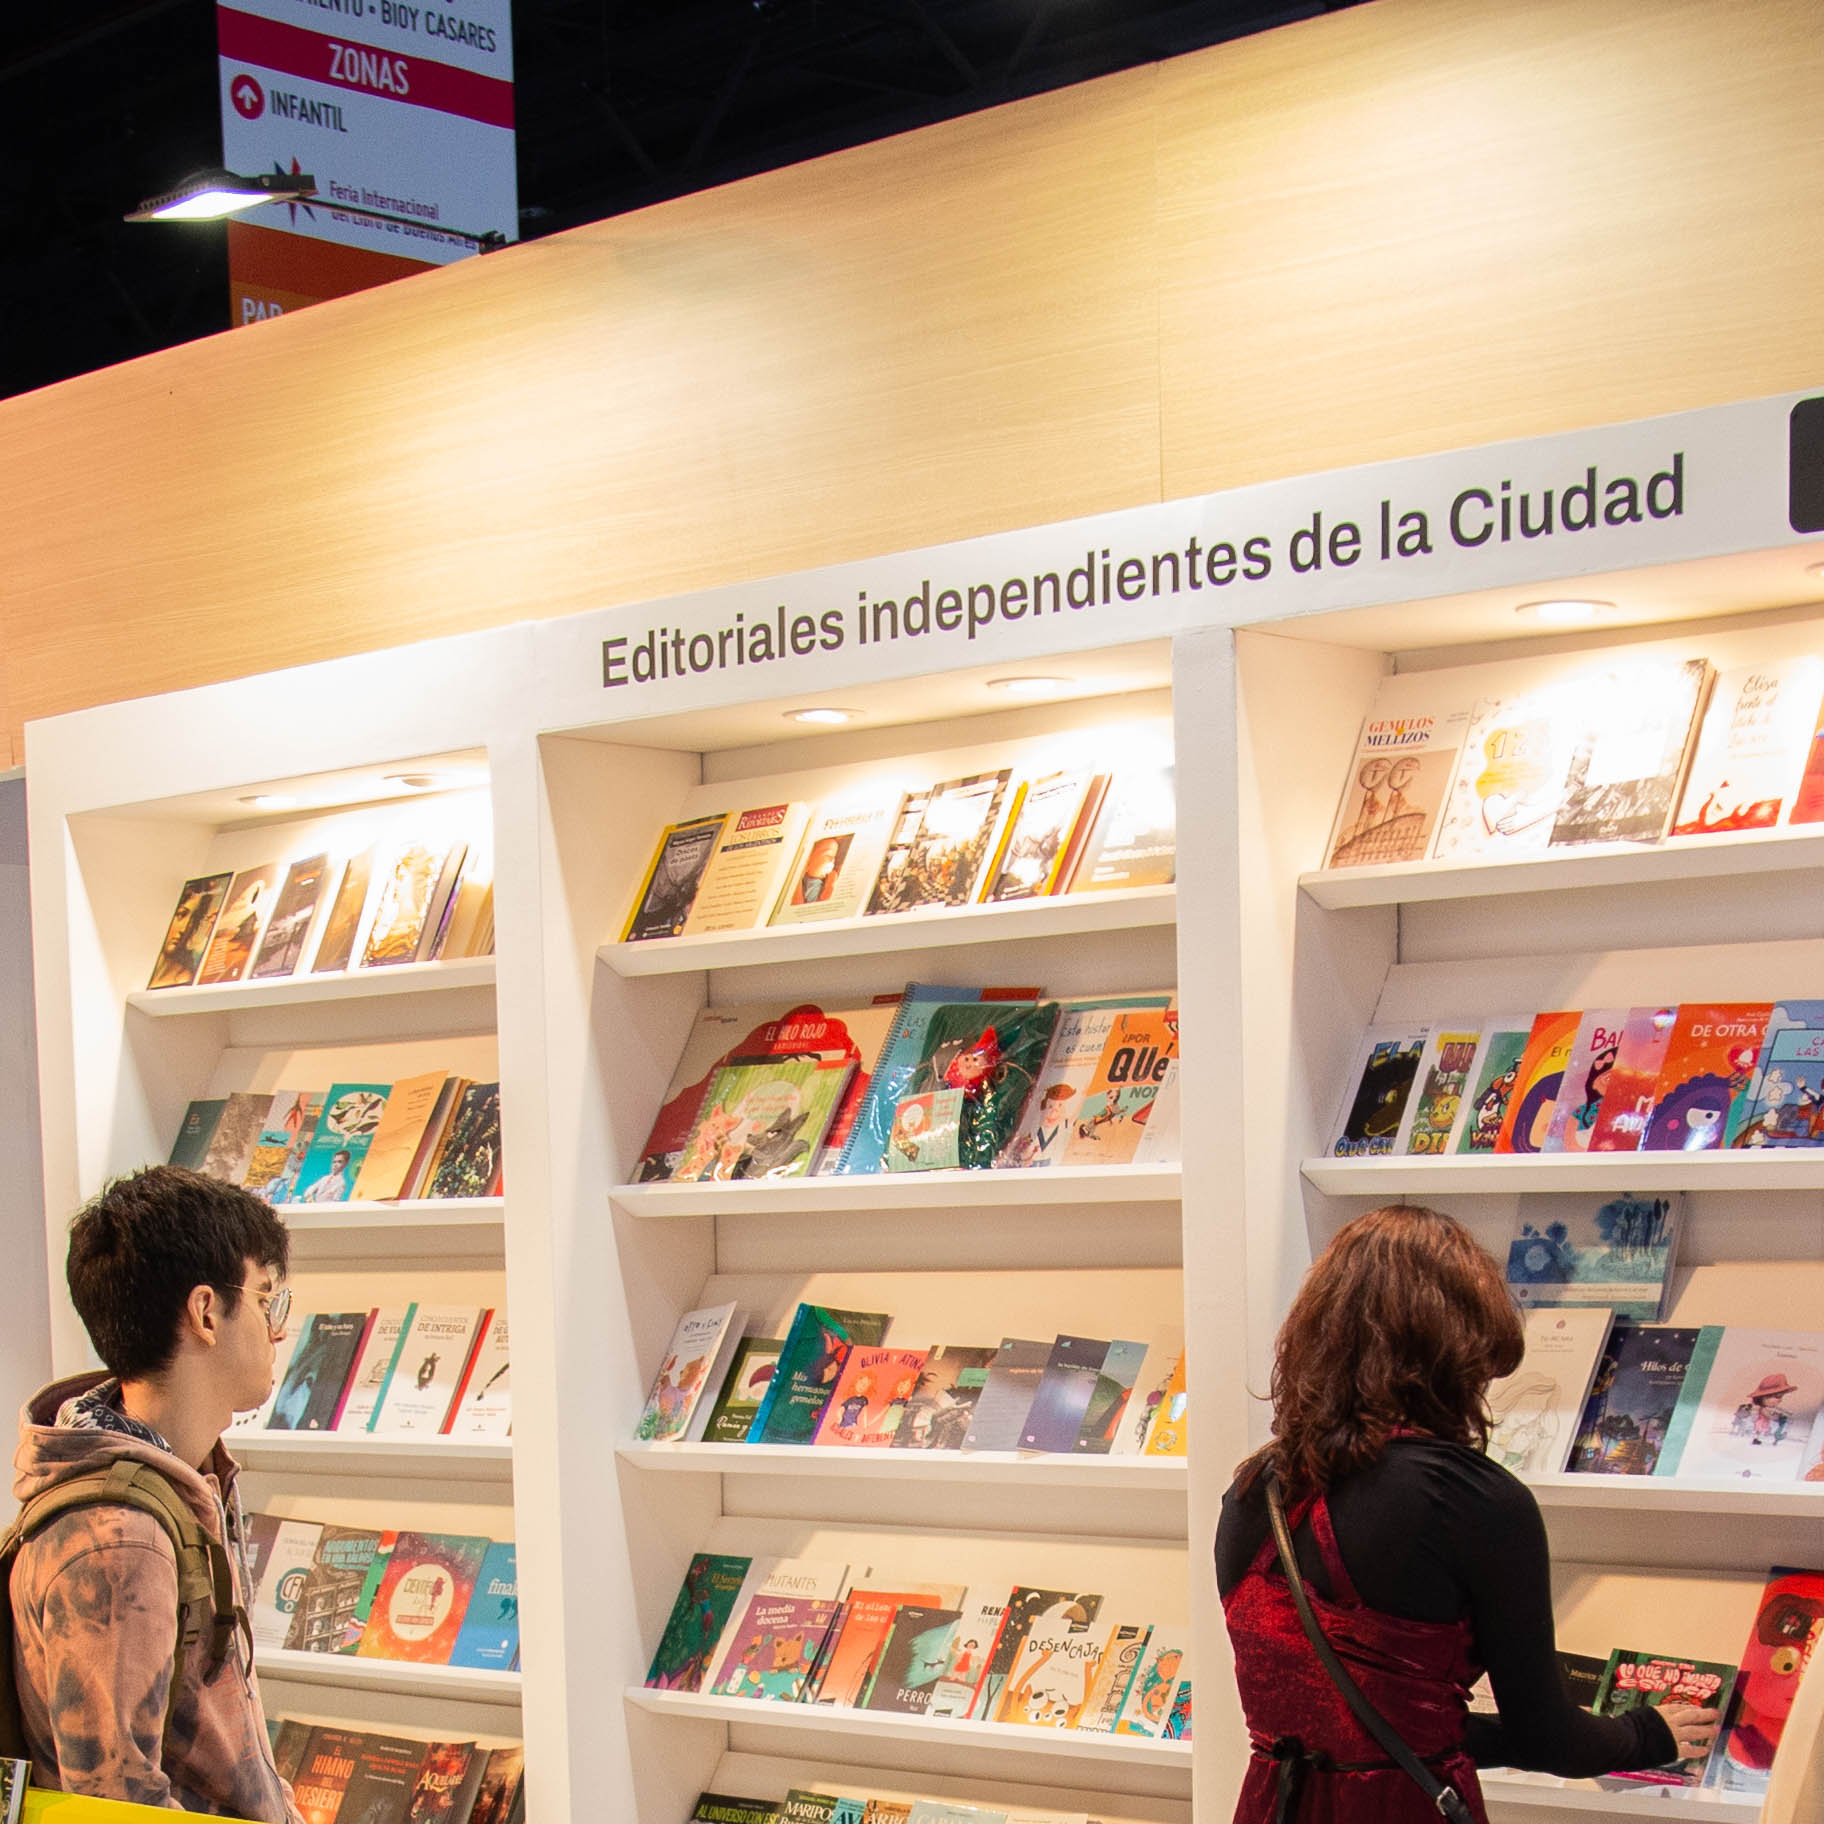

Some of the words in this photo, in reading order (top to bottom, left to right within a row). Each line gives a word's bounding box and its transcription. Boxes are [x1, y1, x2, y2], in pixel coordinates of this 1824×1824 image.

[382, 1, 419, 32] BIOY
[426, 11, 496, 52] CASARES
[329, 44, 410, 95] ZONAS
[270, 90, 348, 133] INFANTIL
[330, 180, 359, 203] Feria
[362, 188, 440, 220] Internacional
[601, 605, 844, 689] Editoriales
[857, 530, 1273, 650] independientes
[1288, 519, 1362, 574] de
[1379, 498, 1433, 560] la
[1449, 452, 1686, 549] Ciudad
[1369, 716, 1435, 734] GEMELOS
[1365, 730, 1430, 747] MELLIZOS
[765, 1026, 777, 1041] EL
[800, 1023, 827, 1039] ROJO
[1122, 1034, 1151, 1043] ¿POR
[1691, 1024, 1712, 1038] DE
[1715, 1024, 1757, 1038] OTRA
[1370, 1041, 1401, 1067] EL
[1796, 1047, 1822, 1058] LAS
[861, 1352, 890, 1369] OLIVIA
[767, 1574, 817, 1591] MUTANTES
[756, 1607, 767, 1616] La
[768, 1604, 795, 1614] media
[757, 1614, 789, 1626] docena
[312, 1754, 355, 1779] HIMNO
[696, 1804, 710, 1819] AL
[709, 1806, 746, 1824] UNIVERSO
